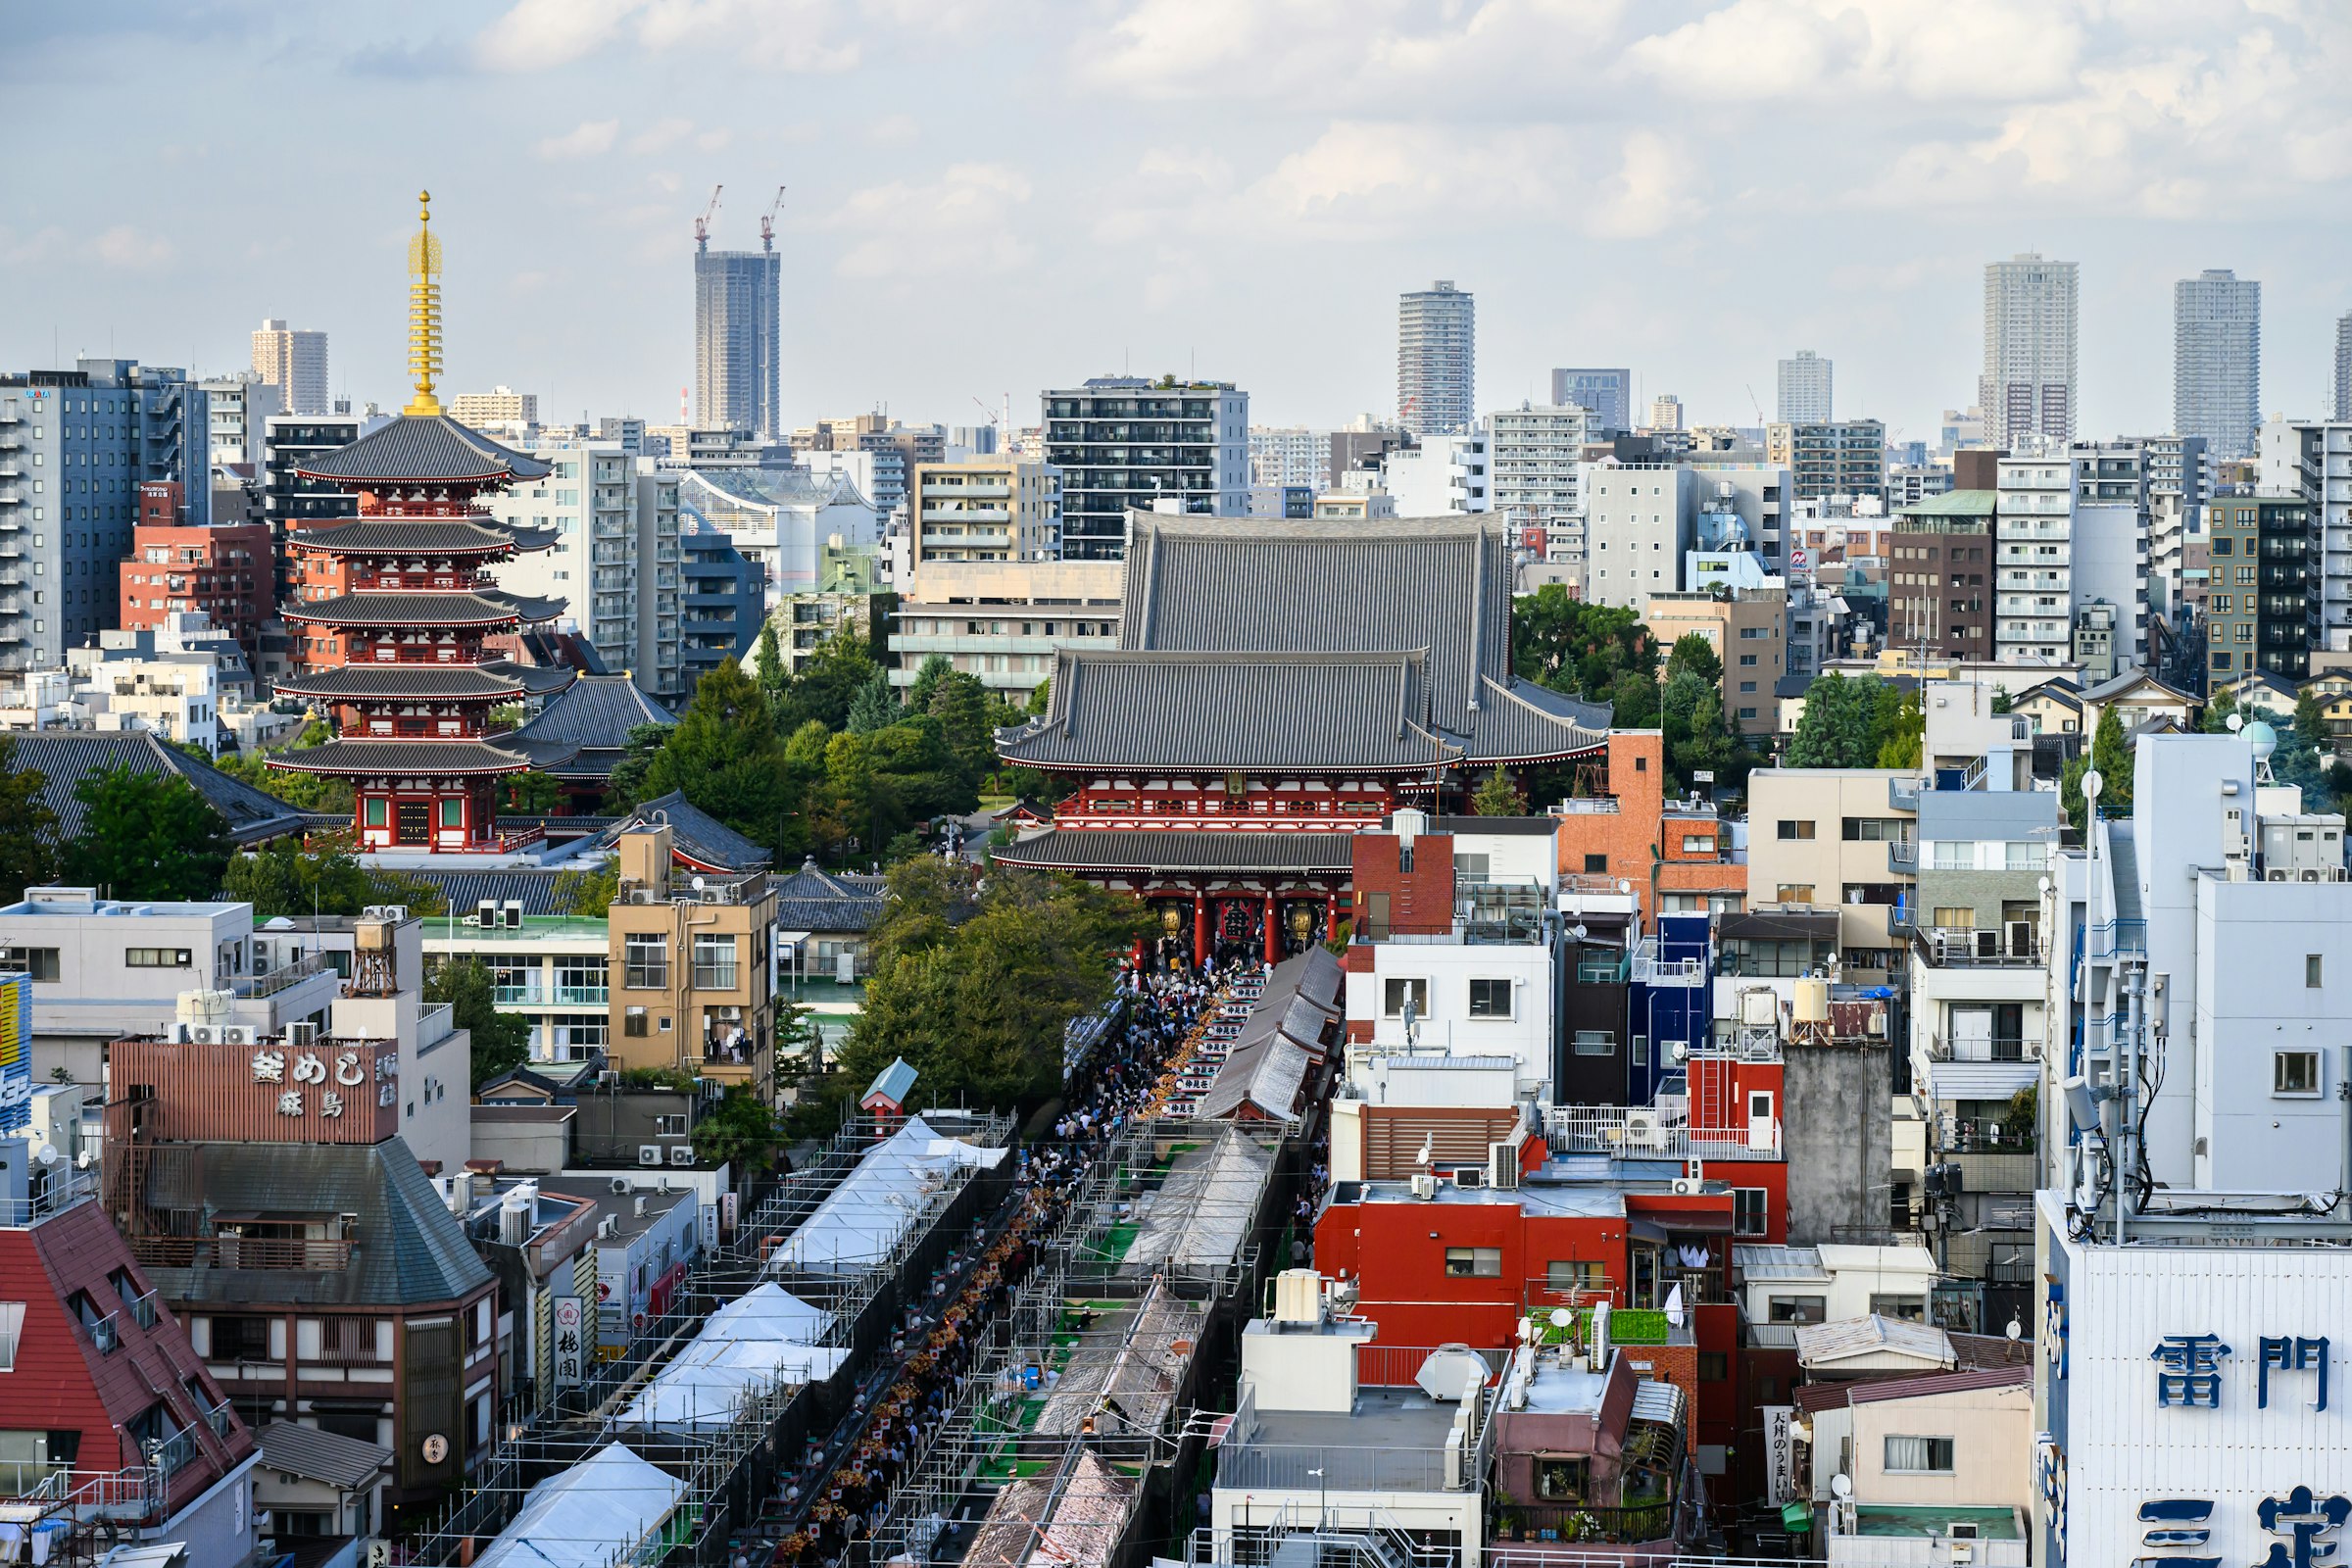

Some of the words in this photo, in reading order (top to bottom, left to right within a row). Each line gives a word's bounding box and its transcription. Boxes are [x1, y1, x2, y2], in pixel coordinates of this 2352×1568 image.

[275, 1089, 343, 1118] 麻鳥
[558, 1330, 579, 1378] 梅園
[2150, 1331, 2330, 1412] 雷門
[1772, 1411, 1788, 1503] 天丼のうまい店
[2130, 1485, 2352, 1568] 三定
